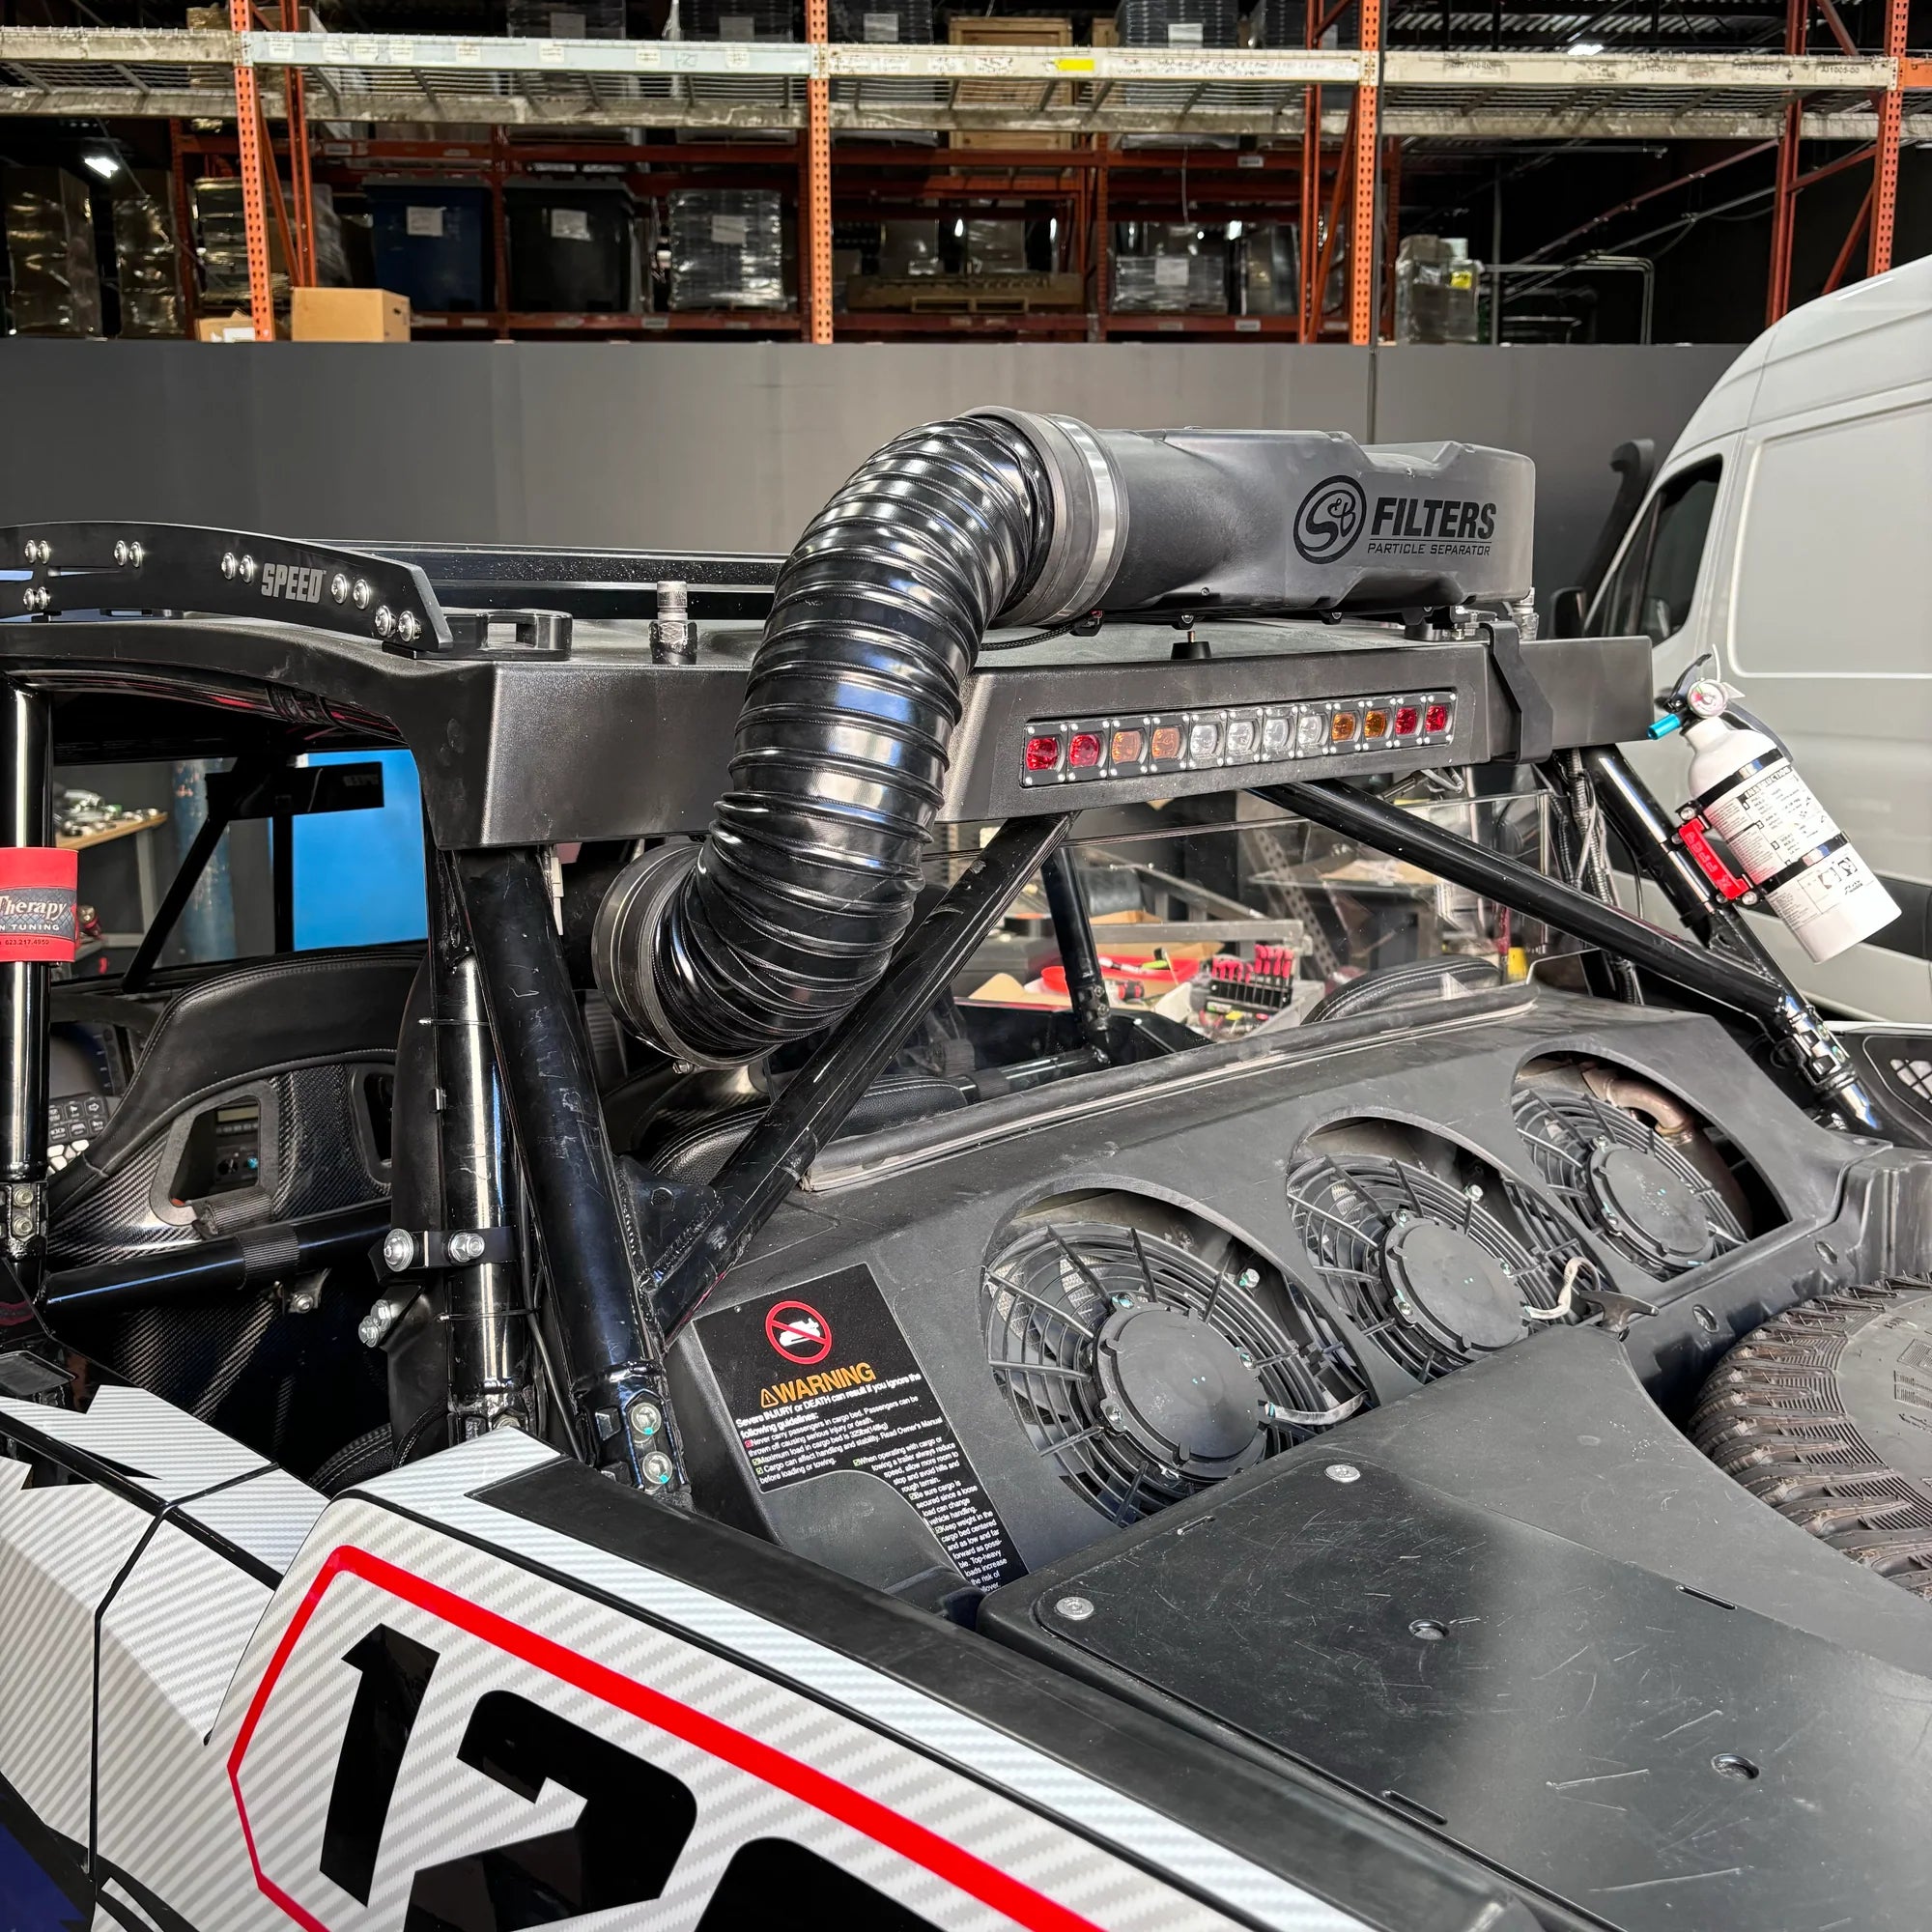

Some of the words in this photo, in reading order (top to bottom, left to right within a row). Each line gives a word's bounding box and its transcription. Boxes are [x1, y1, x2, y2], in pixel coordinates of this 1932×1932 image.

[1371, 497, 1496, 539] FILTERS
[1368, 543, 1426, 554] PARTICLE
[1430, 545, 1491, 556] SEPARATOR
[261, 562, 324, 604] SPEED
[0, 895, 68, 921] Therapy
[772, 1362, 877, 1404] WARNING
[735, 1414, 765, 1428] Severe
[763, 1405, 793, 1420] INJURY
[794, 1404, 803, 1412] or
[803, 1395, 832, 1409] DEATH
[831, 1393, 846, 1403] can
[845, 1386, 867, 1399] result
[871, 1382, 887, 1394] you
[885, 1376, 910, 1389] ignore
[908, 1373, 922, 1381] the
[740, 1424, 778, 1439] following
[777, 1412, 819, 1431] guidelines:
[771, 1432, 787, 1440] carry
[787, 1421, 825, 1437] passengers
[832, 1414, 850, 1424] cargo
[849, 1409, 864, 1419] bed.
[863, 1401, 899, 1415] Passengers
[748, 1446, 771, 1458] thrown
[771, 1441, 781, 1451] off
[781, 1436, 807, 1448] causing
[806, 1430, 830, 1441] serious
[829, 1425, 846, 1435] injury
[854, 1417, 874, 1427] death.
[763, 1463, 784, 1473] Cargo
[798, 1452, 816, 1463] affect
[815, 1445, 843, 1458] handling
[843, 1440, 856, 1450] and
[856, 1435, 880, 1446] stability.
[880, 1429, 897, 1439] Read
[896, 1423, 922, 1435] Owner's
[921, 1416, 943, 1428] Manual
[789, 1445, 805, 1455] load
[811, 1439, 831, 1449] cargo
[830, 1434, 843, 1444] bed
[871, 1461, 893, 1471] towing
[896, 1454, 915, 1463] trailer
[915, 1448, 936, 1459] always
[935, 1442, 955, 1453] reduce
[877, 1447, 906, 1461] operating
[905, 1442, 919, 1452] with
[919, 1438, 936, 1448] cargo
[759, 1473, 781, 1484] before
[781, 1466, 806, 1478] loading
[812, 1458, 837, 1468] towing.
[883, 1466, 905, 1478] speed,
[904, 1463, 921, 1472] allow
[921, 1458, 937, 1467] more
[936, 1453, 952, 1463] room
[893, 1477, 907, 1486] stop
[907, 1472, 920, 1482] and
[919, 1466, 936, 1478] avoid
[934, 1463, 949, 1472] hills
[948, 1460, 960, 1469] and
[901, 1483, 920, 1492] rough
[919, 1477, 941, 1488] terrain.
[923, 1488, 938, 1496] sure
[937, 1482, 955, 1492] cargo
[916, 1496, 940, 1509] secured
[940, 1492, 956, 1501] since
[960, 1486, 978, 1494] loose
[922, 1507, 936, 1517] load
[948, 1498, 970, 1509] change
[928, 1514, 951, 1525] vehicle
[950, 1506, 978, 1519] handling.
[956, 1516, 977, 1527] weight
[941, 1533, 958, 1543] cargo
[957, 1527, 971, 1537] bed
[971, 1519, 997, 1533] centered
[948, 1542, 959, 1551] and
[967, 1536, 979, 1545] low
[979, 1531, 991, 1541] and
[952, 1547, 976, 1560] forward
[984, 1538, 1002, 1550] possi-
[970, 1549, 1001, 1564] Top-heavy
[964, 1567, 981, 1577] loads
[981, 1558, 1008, 1571] increase
[981, 1574, 993, 1582] risk
